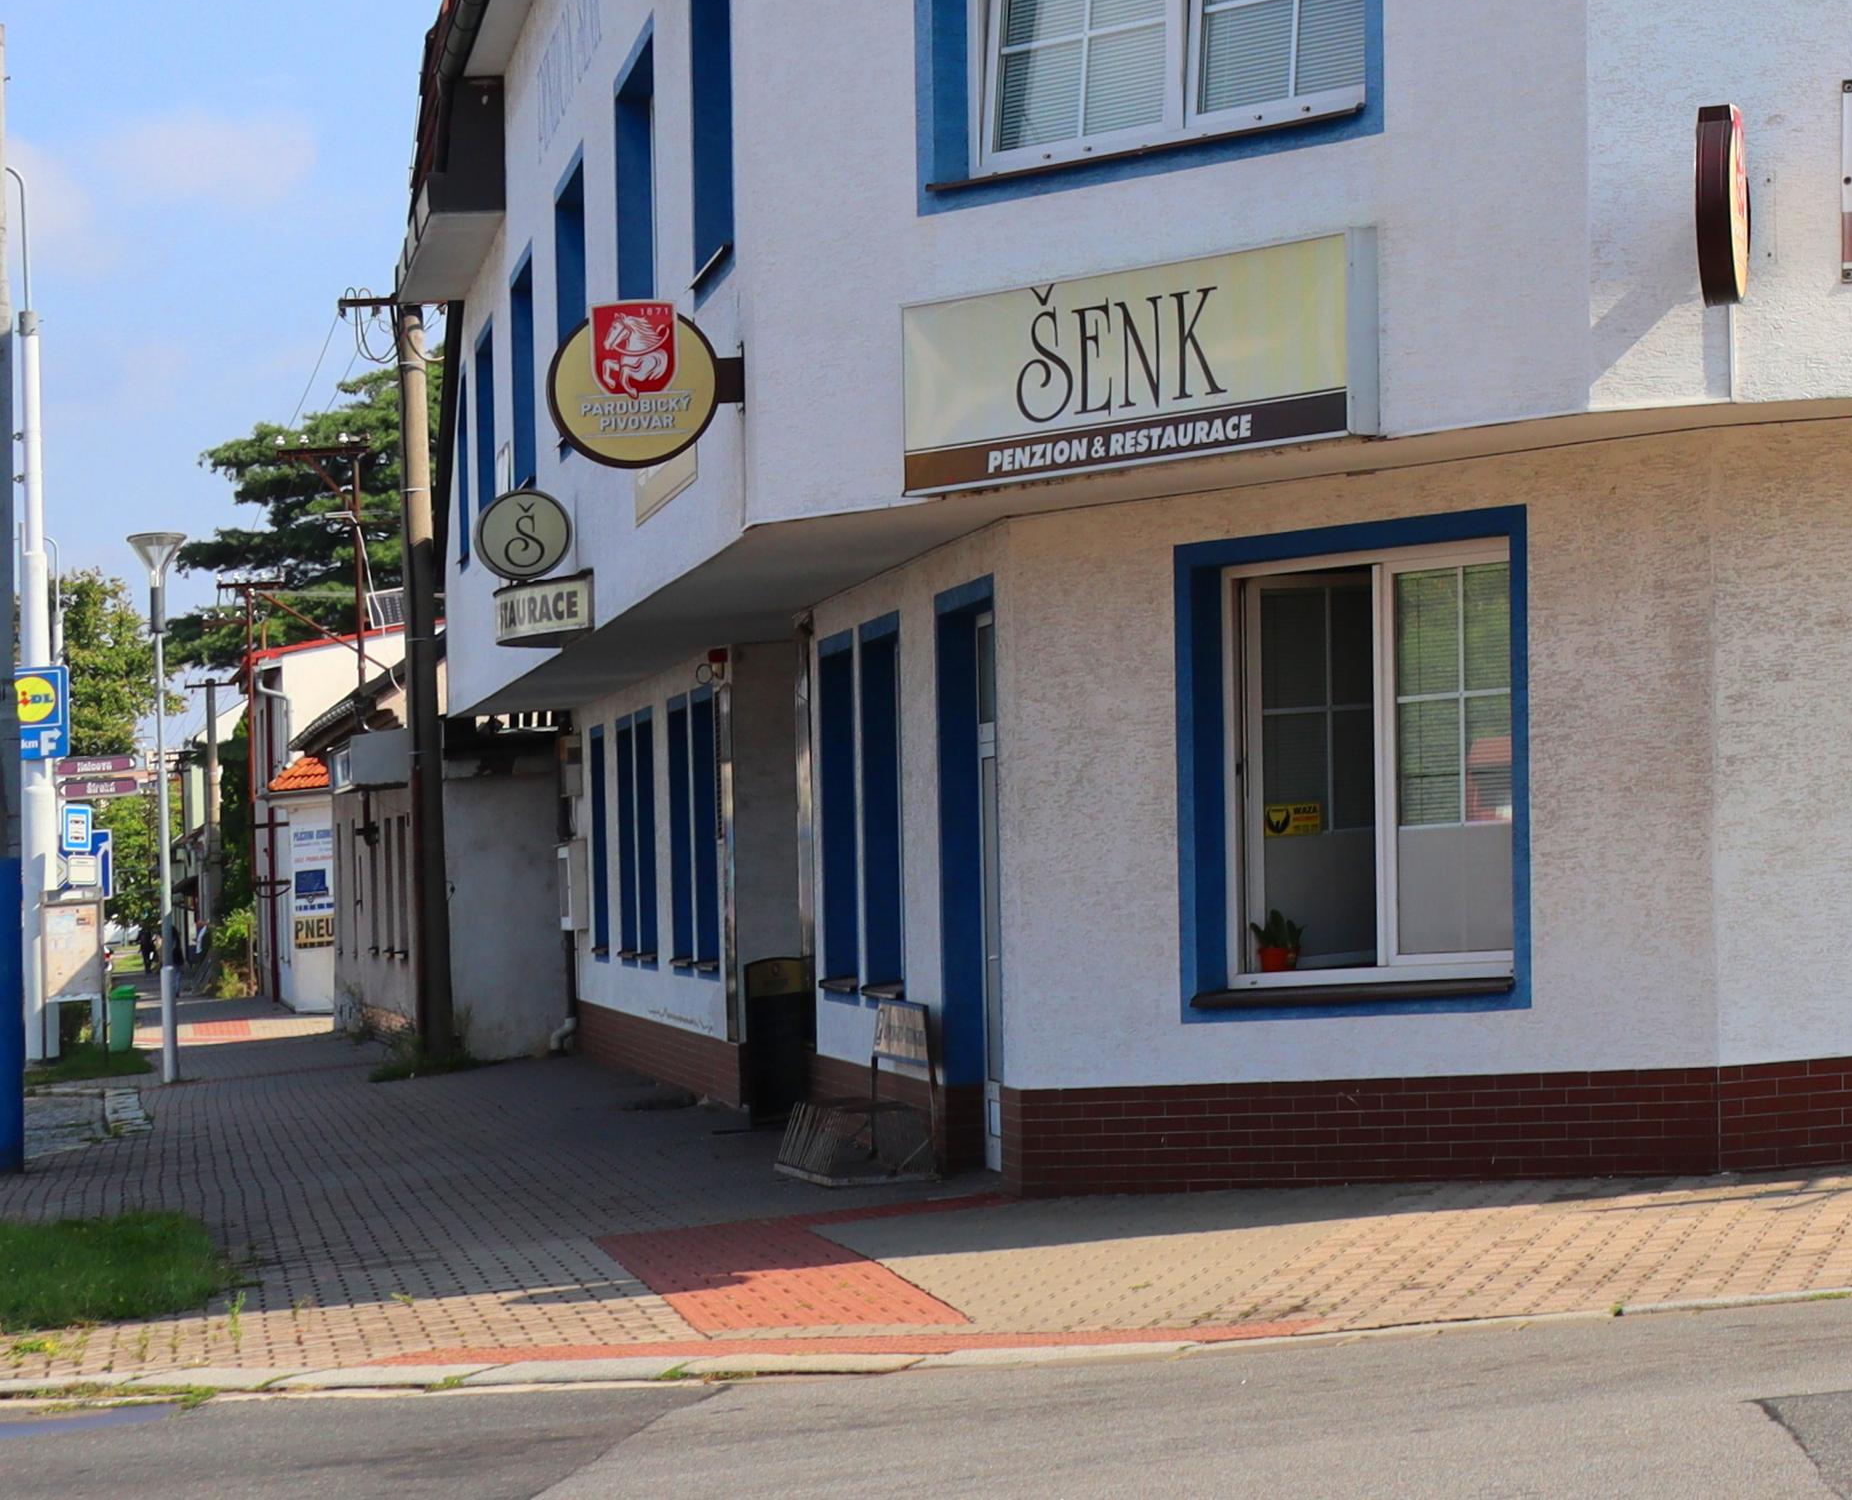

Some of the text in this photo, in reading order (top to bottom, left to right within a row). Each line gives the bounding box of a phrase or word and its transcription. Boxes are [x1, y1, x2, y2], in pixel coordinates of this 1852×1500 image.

[1016, 283, 1228, 422] ŠENK
[581, 393, 691, 416] PARDUBICKÝ
[600, 414, 675, 431] PIVOVAR
[988, 414, 1252, 473] PENZION & RESTAURACE
[295, 918, 335, 940] PNEU
